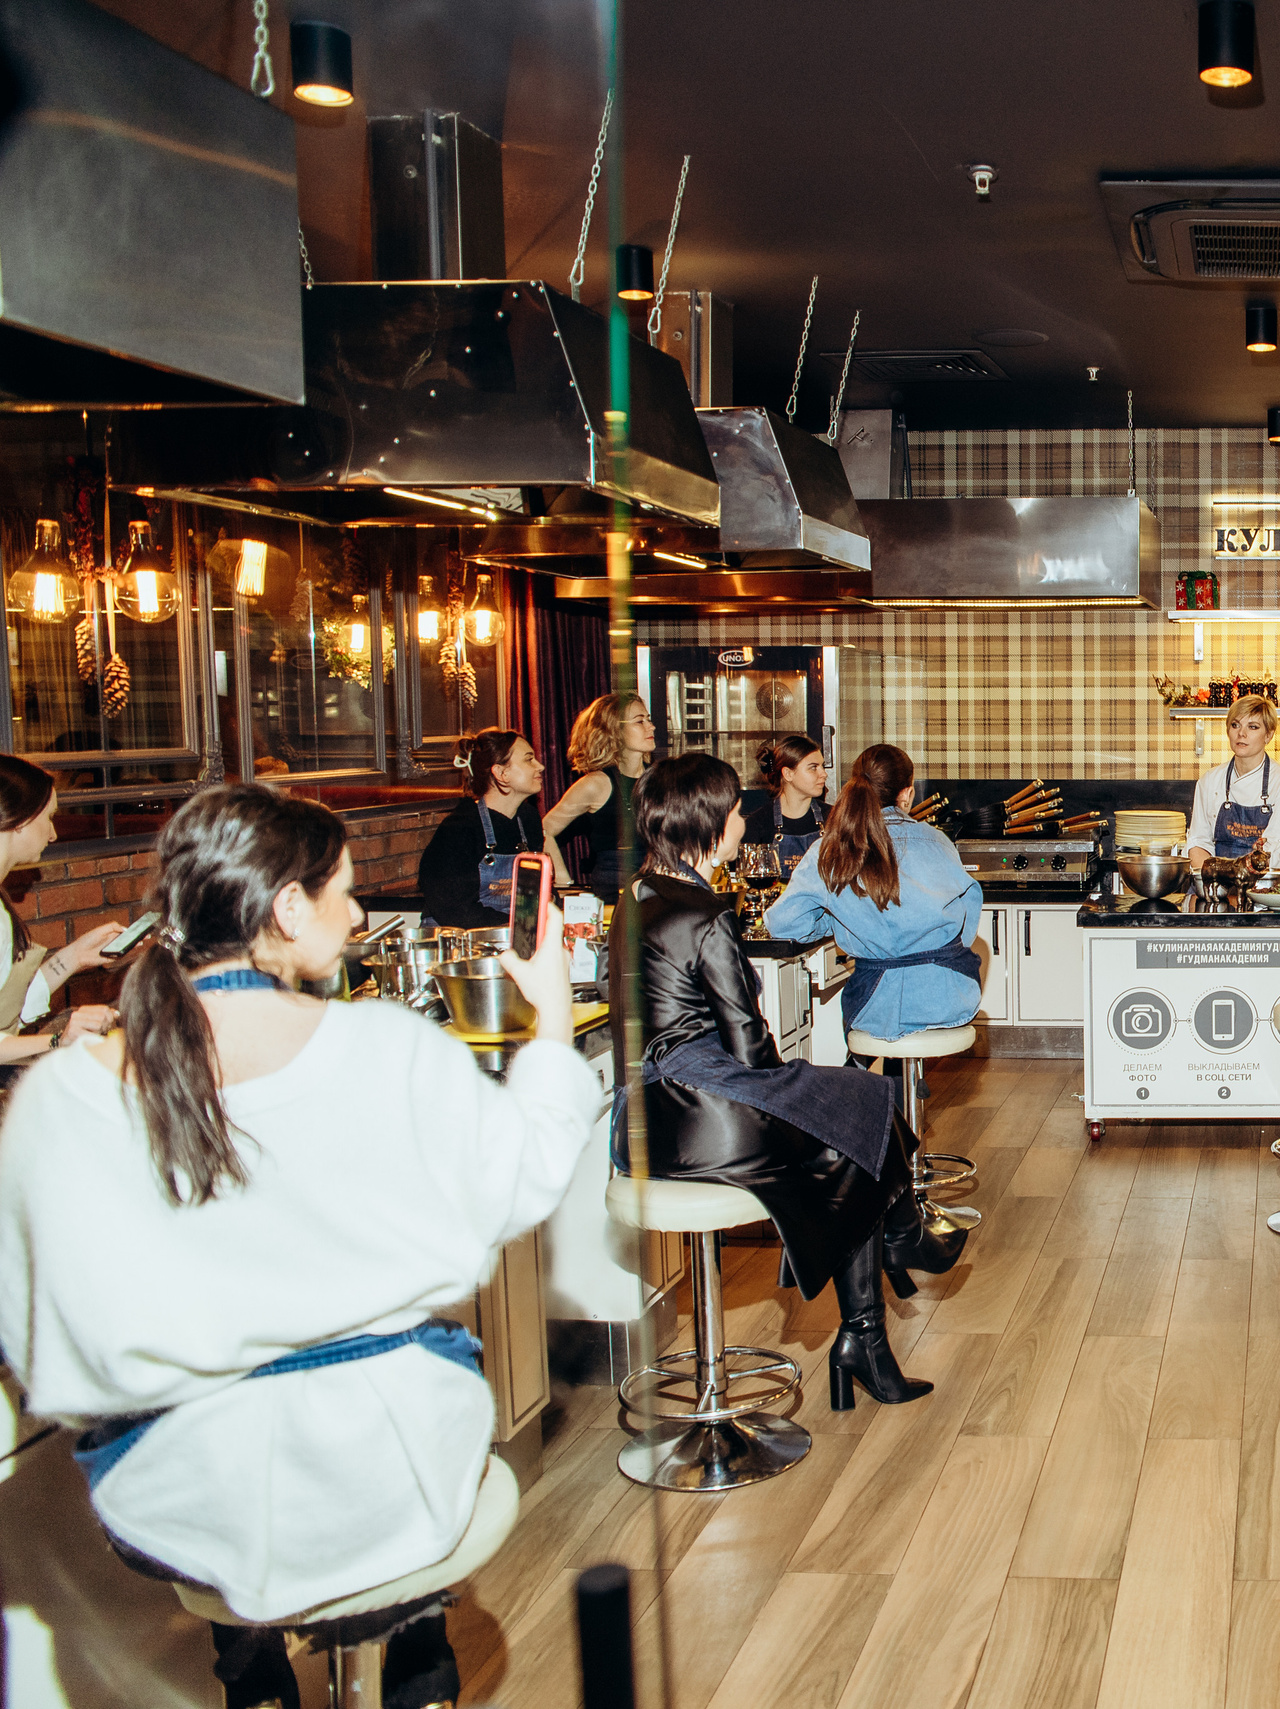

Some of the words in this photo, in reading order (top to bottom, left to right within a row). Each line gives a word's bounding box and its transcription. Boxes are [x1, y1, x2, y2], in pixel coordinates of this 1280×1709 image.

[722, 654, 746, 662] UNO
[1176, 954, 1270, 965] #ГУДМАНАКАДЕМИЯ
[1122, 1063, 1162, 1072] ДЕЛАЕМ
[1187, 1062, 1260, 1072] ВЫКЛАДЫВАЕМ
[1128, 1074, 1157, 1082] ФОТО
[1204, 1073, 1226, 1082] СОЦ.
[1228, 1073, 1252, 1081] СЕТИ
